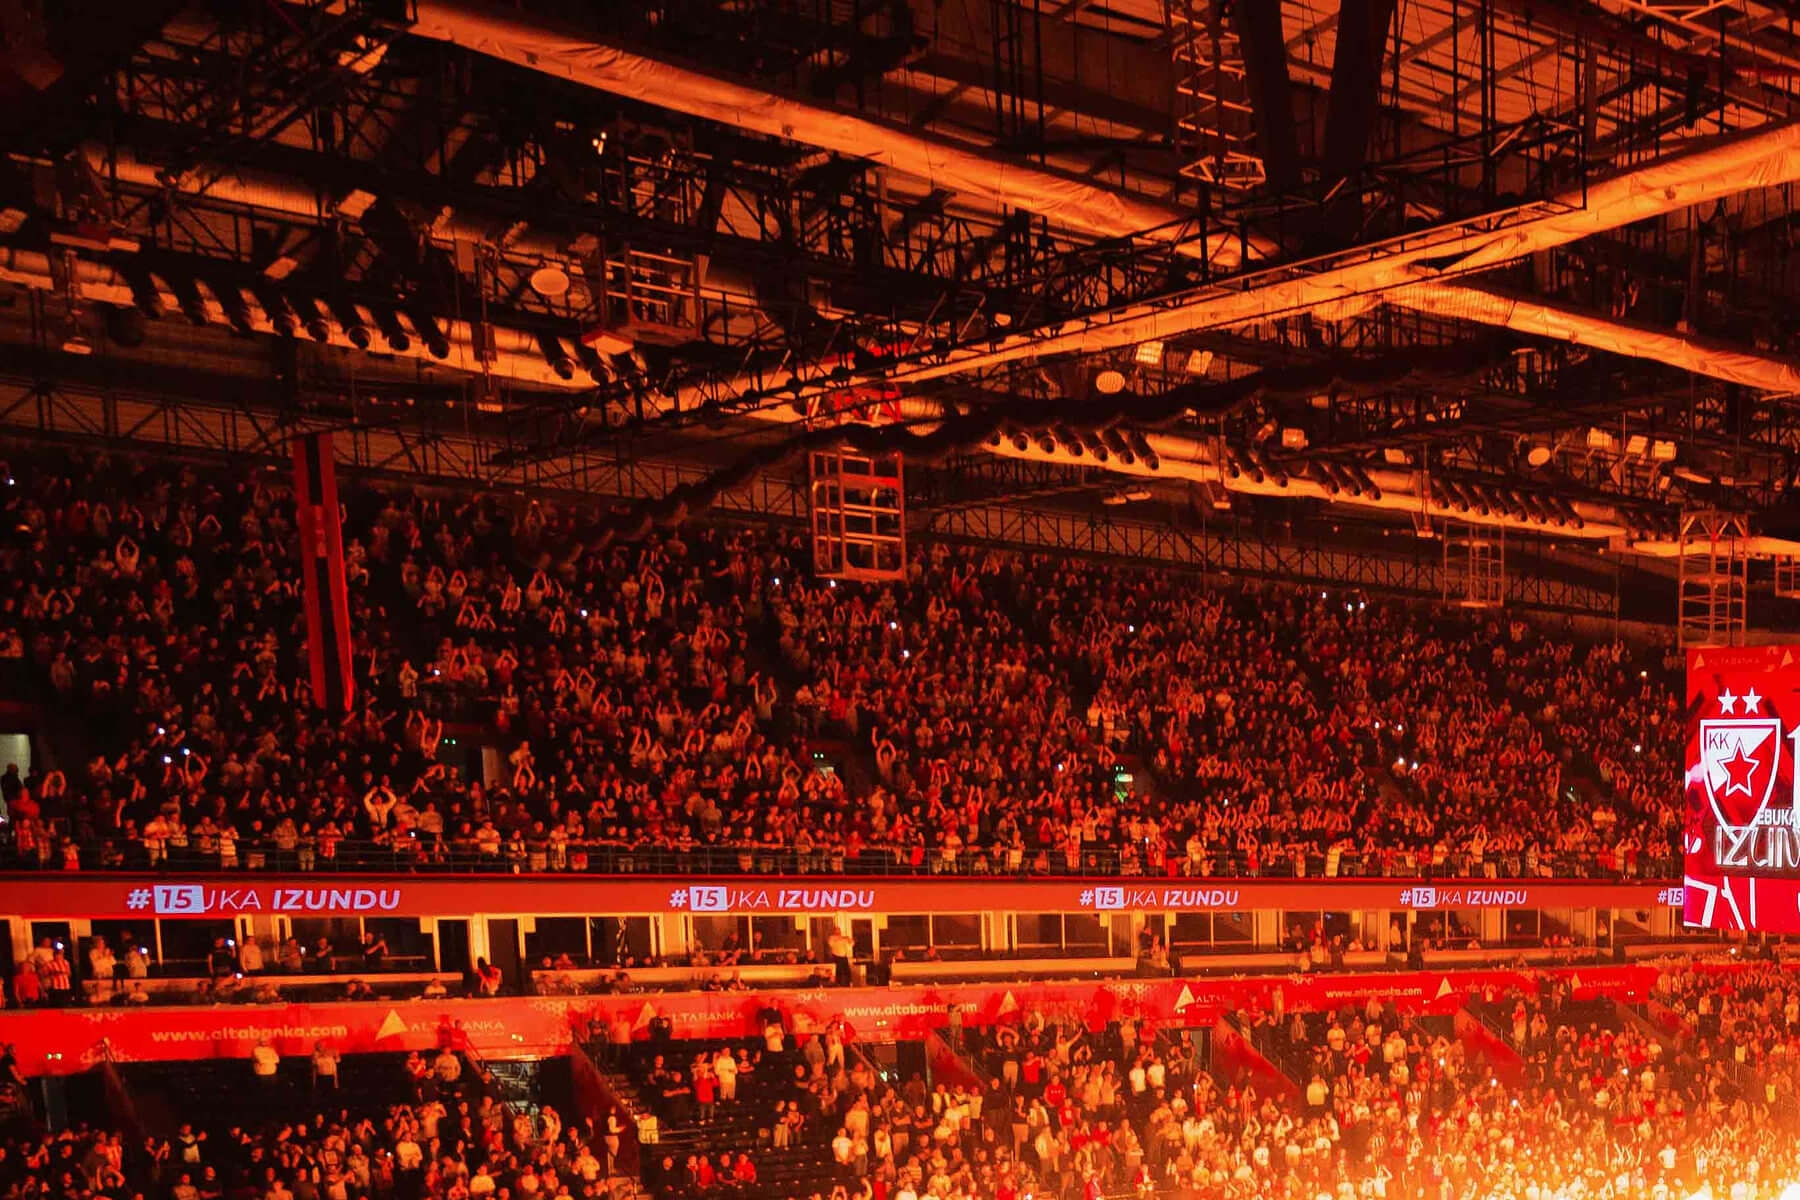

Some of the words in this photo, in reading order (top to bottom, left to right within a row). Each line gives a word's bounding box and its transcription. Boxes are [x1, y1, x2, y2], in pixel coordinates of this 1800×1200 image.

[1708, 731, 1730, 750] KK
[273, 889, 401, 910] IZUNDU
[778, 889, 875, 909] IZUNDU
[1163, 890, 1240, 907] IZUNDU
[1466, 890, 1527, 905] IZUNDU
[151, 1024, 348, 1042] www.altabanka.com
